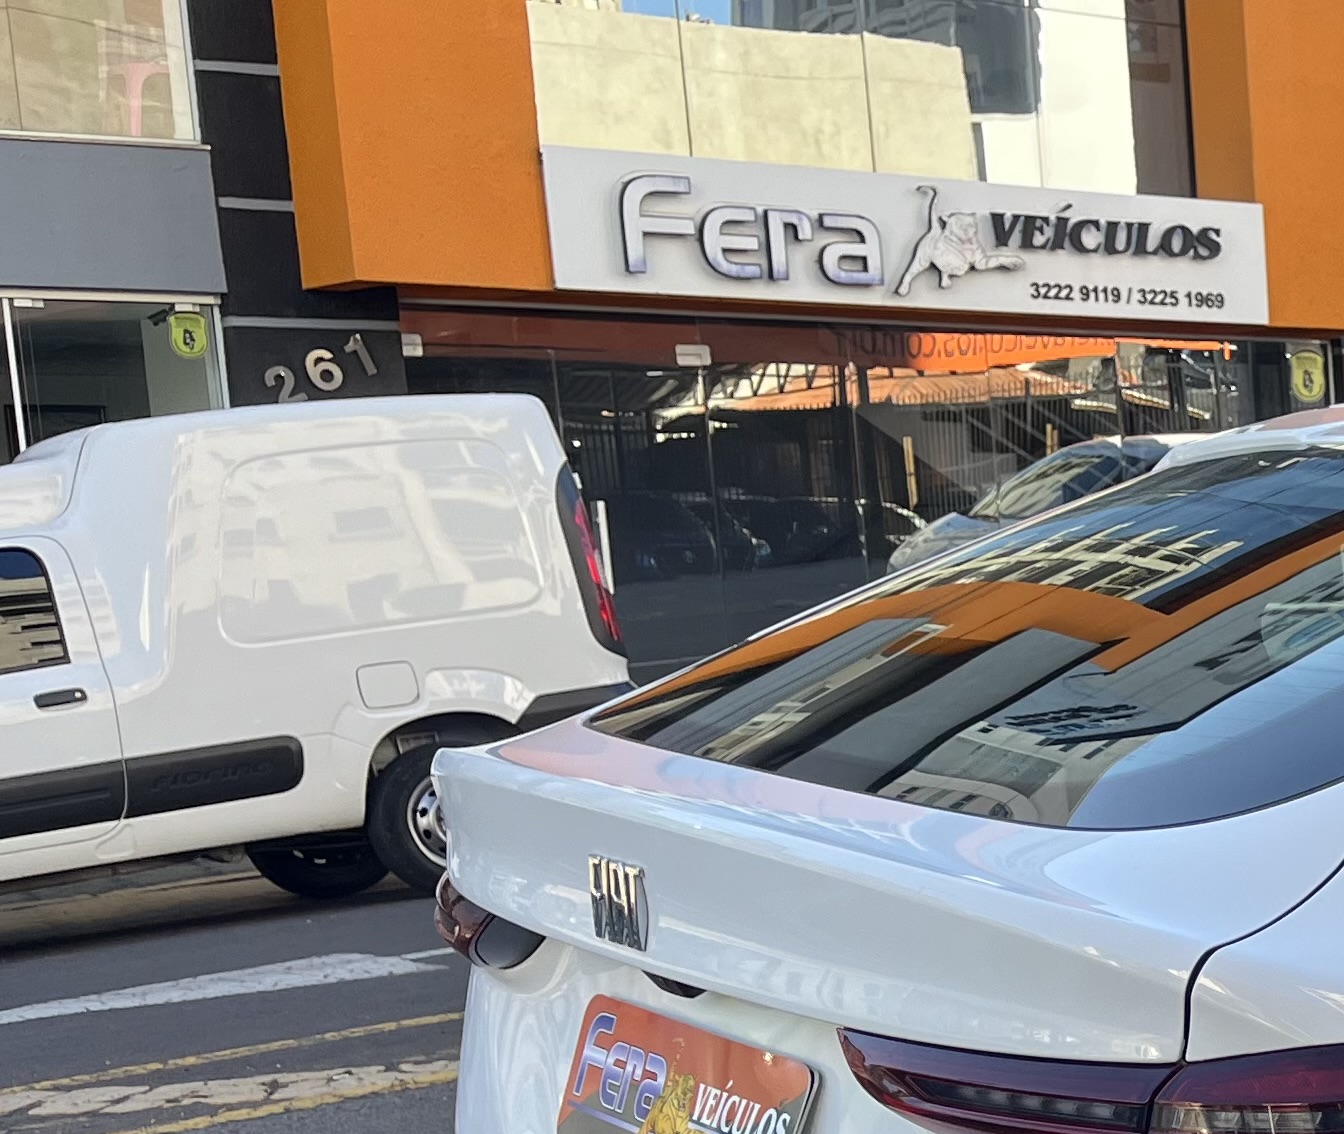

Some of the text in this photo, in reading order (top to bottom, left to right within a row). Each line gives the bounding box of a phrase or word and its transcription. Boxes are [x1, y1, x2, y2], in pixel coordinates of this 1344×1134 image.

[617, 172, 885, 287] Fera
[989, 203, 1222, 261] VEÍCULOS
[1030, 282, 1225, 309] 3222 9119 / 3225 1969
[263, 333, 378, 404] 261
[588, 853, 647, 952] FIAT
[572, 1012, 668, 1123] Fera
